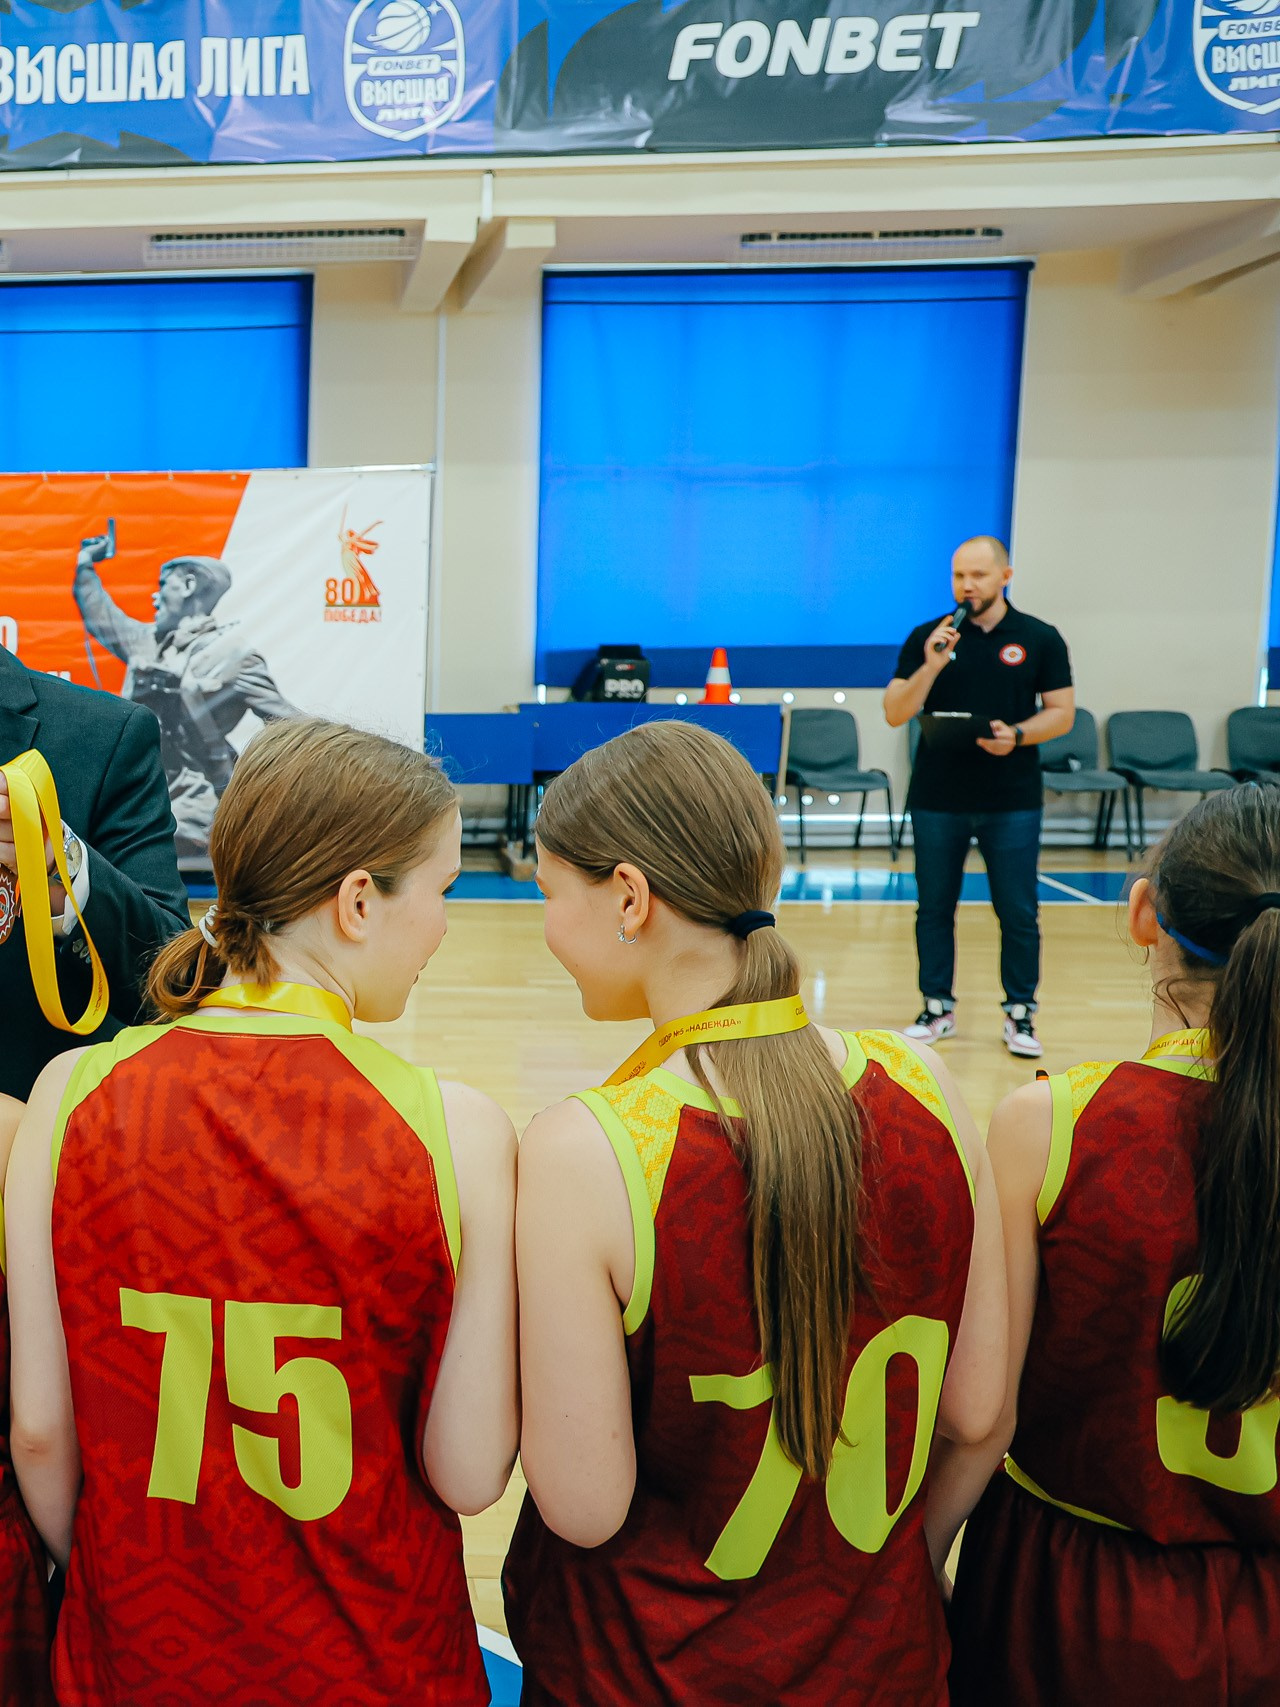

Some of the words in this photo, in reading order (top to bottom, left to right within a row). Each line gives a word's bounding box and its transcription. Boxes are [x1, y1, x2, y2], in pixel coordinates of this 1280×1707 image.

[196, 34, 311, 98] ЛИГА
[373, 58, 435, 72] FONBET
[667, 11, 981, 81] FONBET
[361, 76, 450, 107] ВЫСШАЯ
[375, 105, 437, 123] ЛИГА
[685, 1018, 742, 1033] «НАДЕЖДА»
[119, 1287, 353, 1521] 75
[688, 1314, 949, 1580] 70
